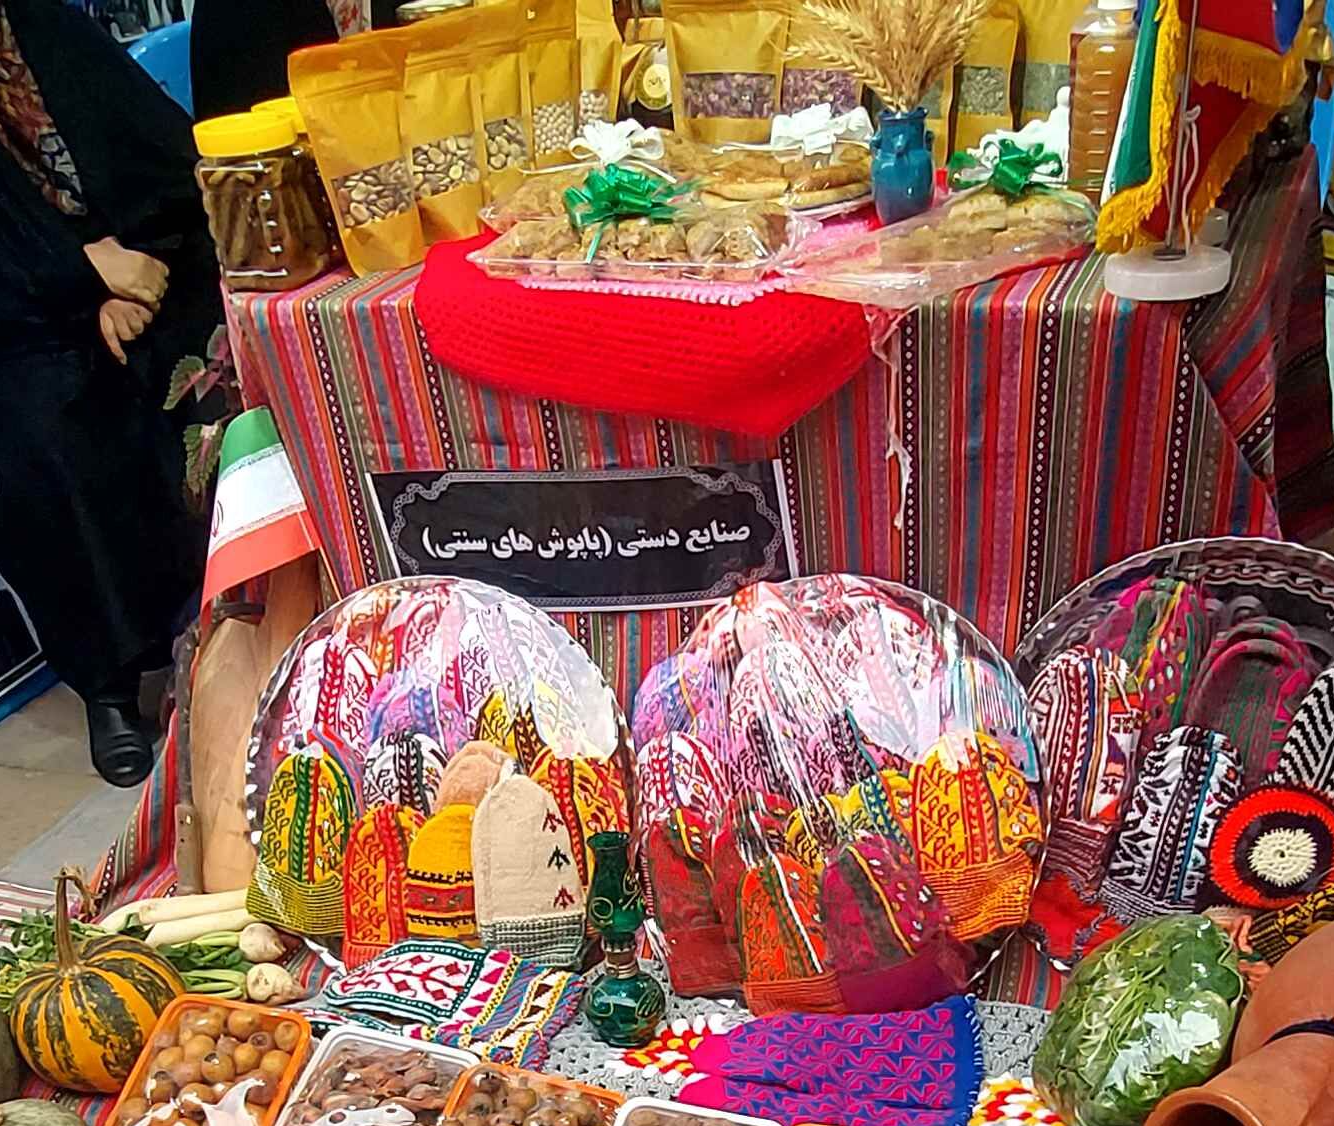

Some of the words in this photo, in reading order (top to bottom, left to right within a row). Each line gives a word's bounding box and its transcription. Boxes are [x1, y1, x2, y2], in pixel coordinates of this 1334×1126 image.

[421, 526, 487, 558] سنتی)
[491, 527, 533, 558] های
[537, 525, 612, 559] (پاپوش
[616, 528, 680, 556] دستی
[685, 519, 750, 552] صنایع
